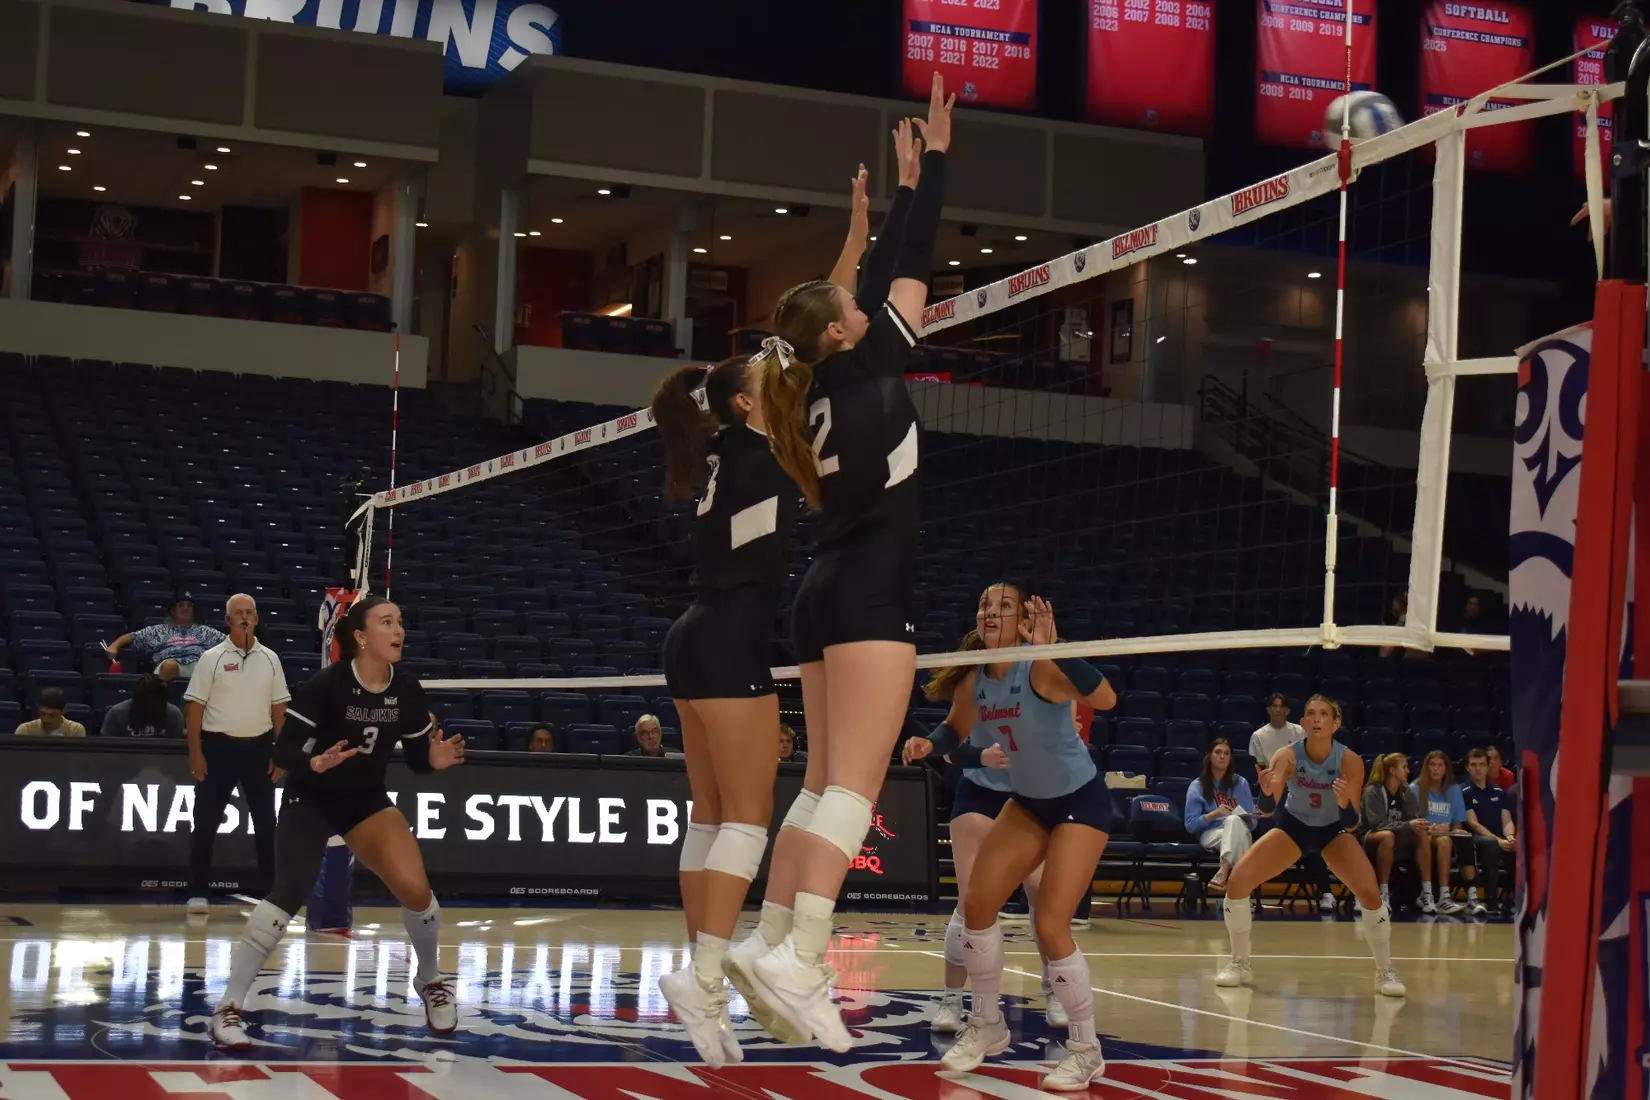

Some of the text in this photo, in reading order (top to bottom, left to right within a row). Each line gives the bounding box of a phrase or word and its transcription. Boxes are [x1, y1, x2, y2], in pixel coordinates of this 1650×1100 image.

[973, 0, 1000, 10] 2023
[1155, 0, 1180, 14] 2003
[1185, 3, 1211, 18] 2004
[1270, 3, 1318, 18] CONFERENCE
[1319, 10, 1363, 24] CHAMPNS
[1445, 3, 1510, 23] SOFTBALL
[1093, 4, 1209, 31] 2006 2007 2008 2021
[1093, 16, 1118, 32] 2023
[1289, 18, 1314, 33] 2009
[1319, 23, 1343, 37] 2019
[929, 23, 1011, 42] NCAA TOURNAMENT
[1433, 27, 1522, 47] CONFERENCE CHAMPIONS
[907, 33, 1030, 60] 2007 2016 2017 2018
[1423, 38, 1448, 52] 2025
[907, 47, 999, 70] 2019 2021 2022
[1577, 60, 1600, 75] 2006
[1260, 83, 1313, 101] 2008 2019
[1280, 74, 1352, 91] NCAA TOURNAME
[1231, 175, 1291, 217] BRUINS
[1112, 223, 1159, 259] BELMONT
[1008, 265, 1051, 298] BRUINS
[921, 299, 956, 329] BELMONT
[809, 397, 841, 478] 2
[345, 705, 400, 722] SALUKIS
[979, 702, 1021, 721] Belmont
[357, 726, 379, 754] 3
[998, 725, 1018, 752] 7
[20, 781, 102, 830] OF
[1309, 793, 1322, 809] 3
[465, 794, 628, 844] STYLE
